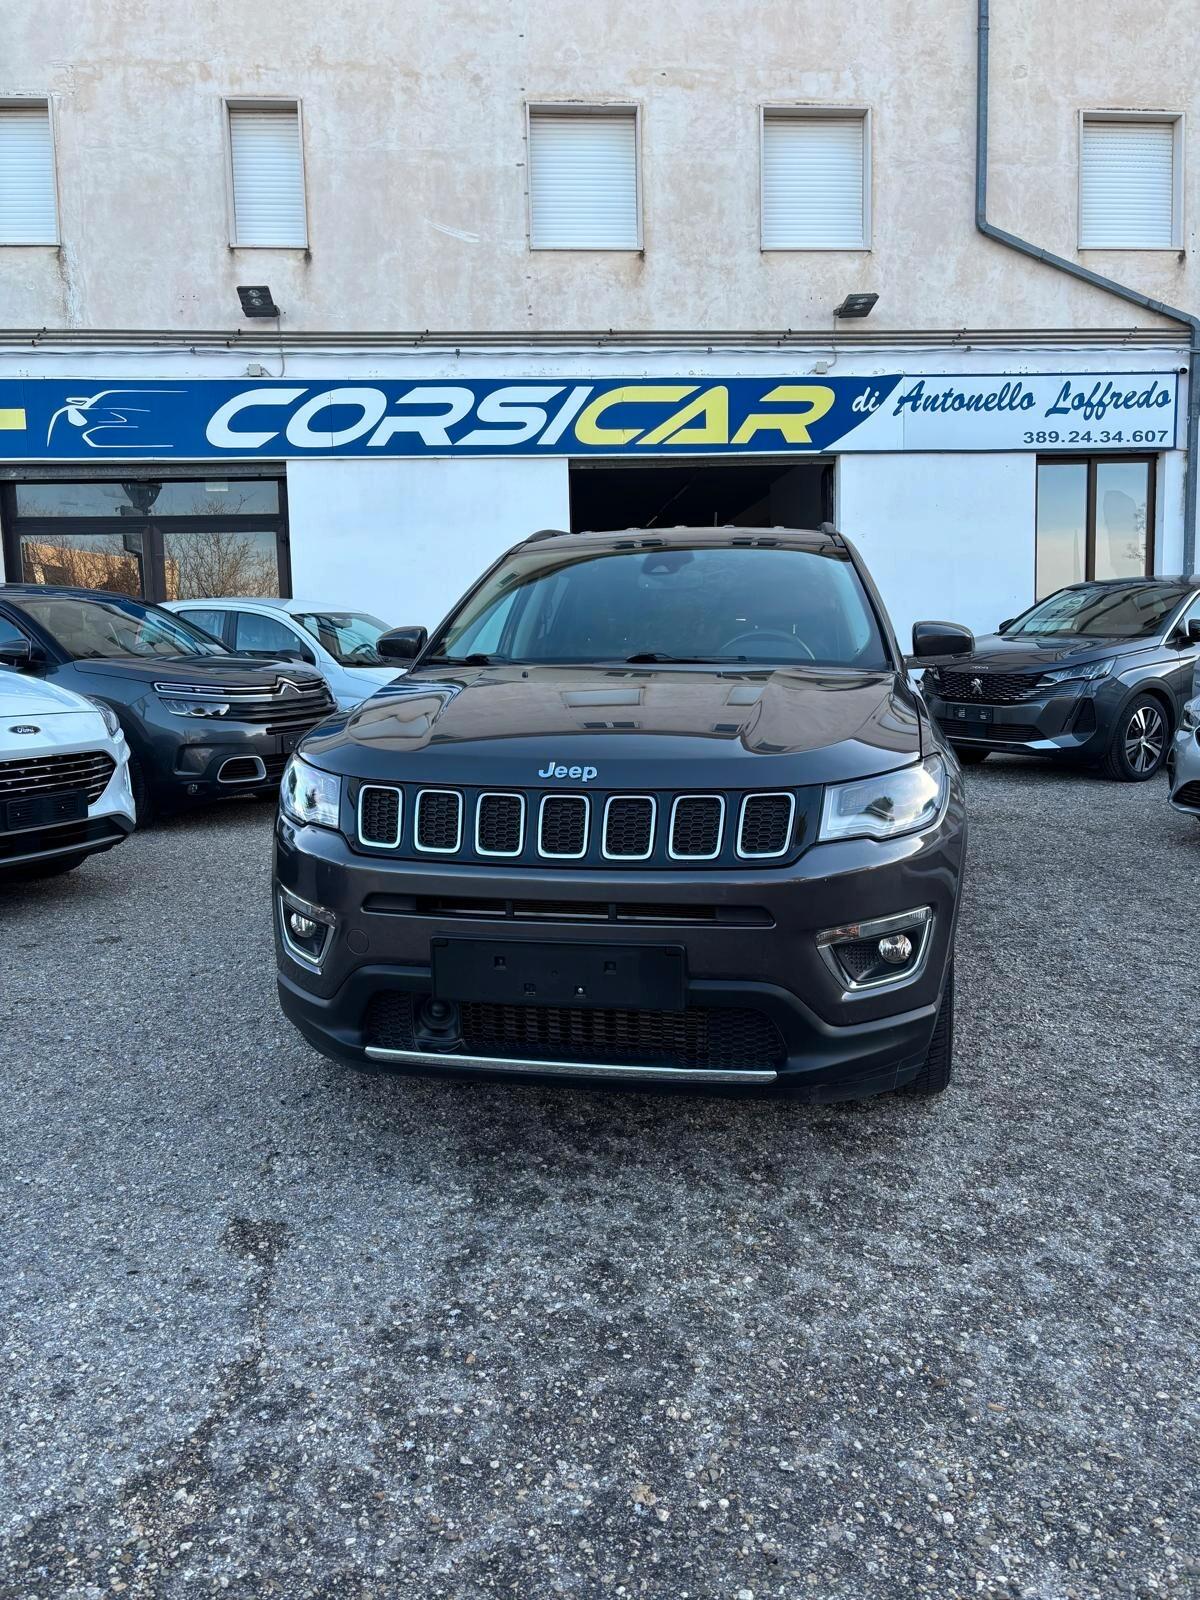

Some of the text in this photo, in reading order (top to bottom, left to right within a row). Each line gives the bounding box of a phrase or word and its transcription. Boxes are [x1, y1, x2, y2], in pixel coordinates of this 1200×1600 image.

[851, 380, 1172, 421] di Antonello Loffredo
[206, 385, 836, 448] CORSICAR
[1023, 430, 1169, 444] 389.24.34.607
[538, 761, 598, 782] Jeep
